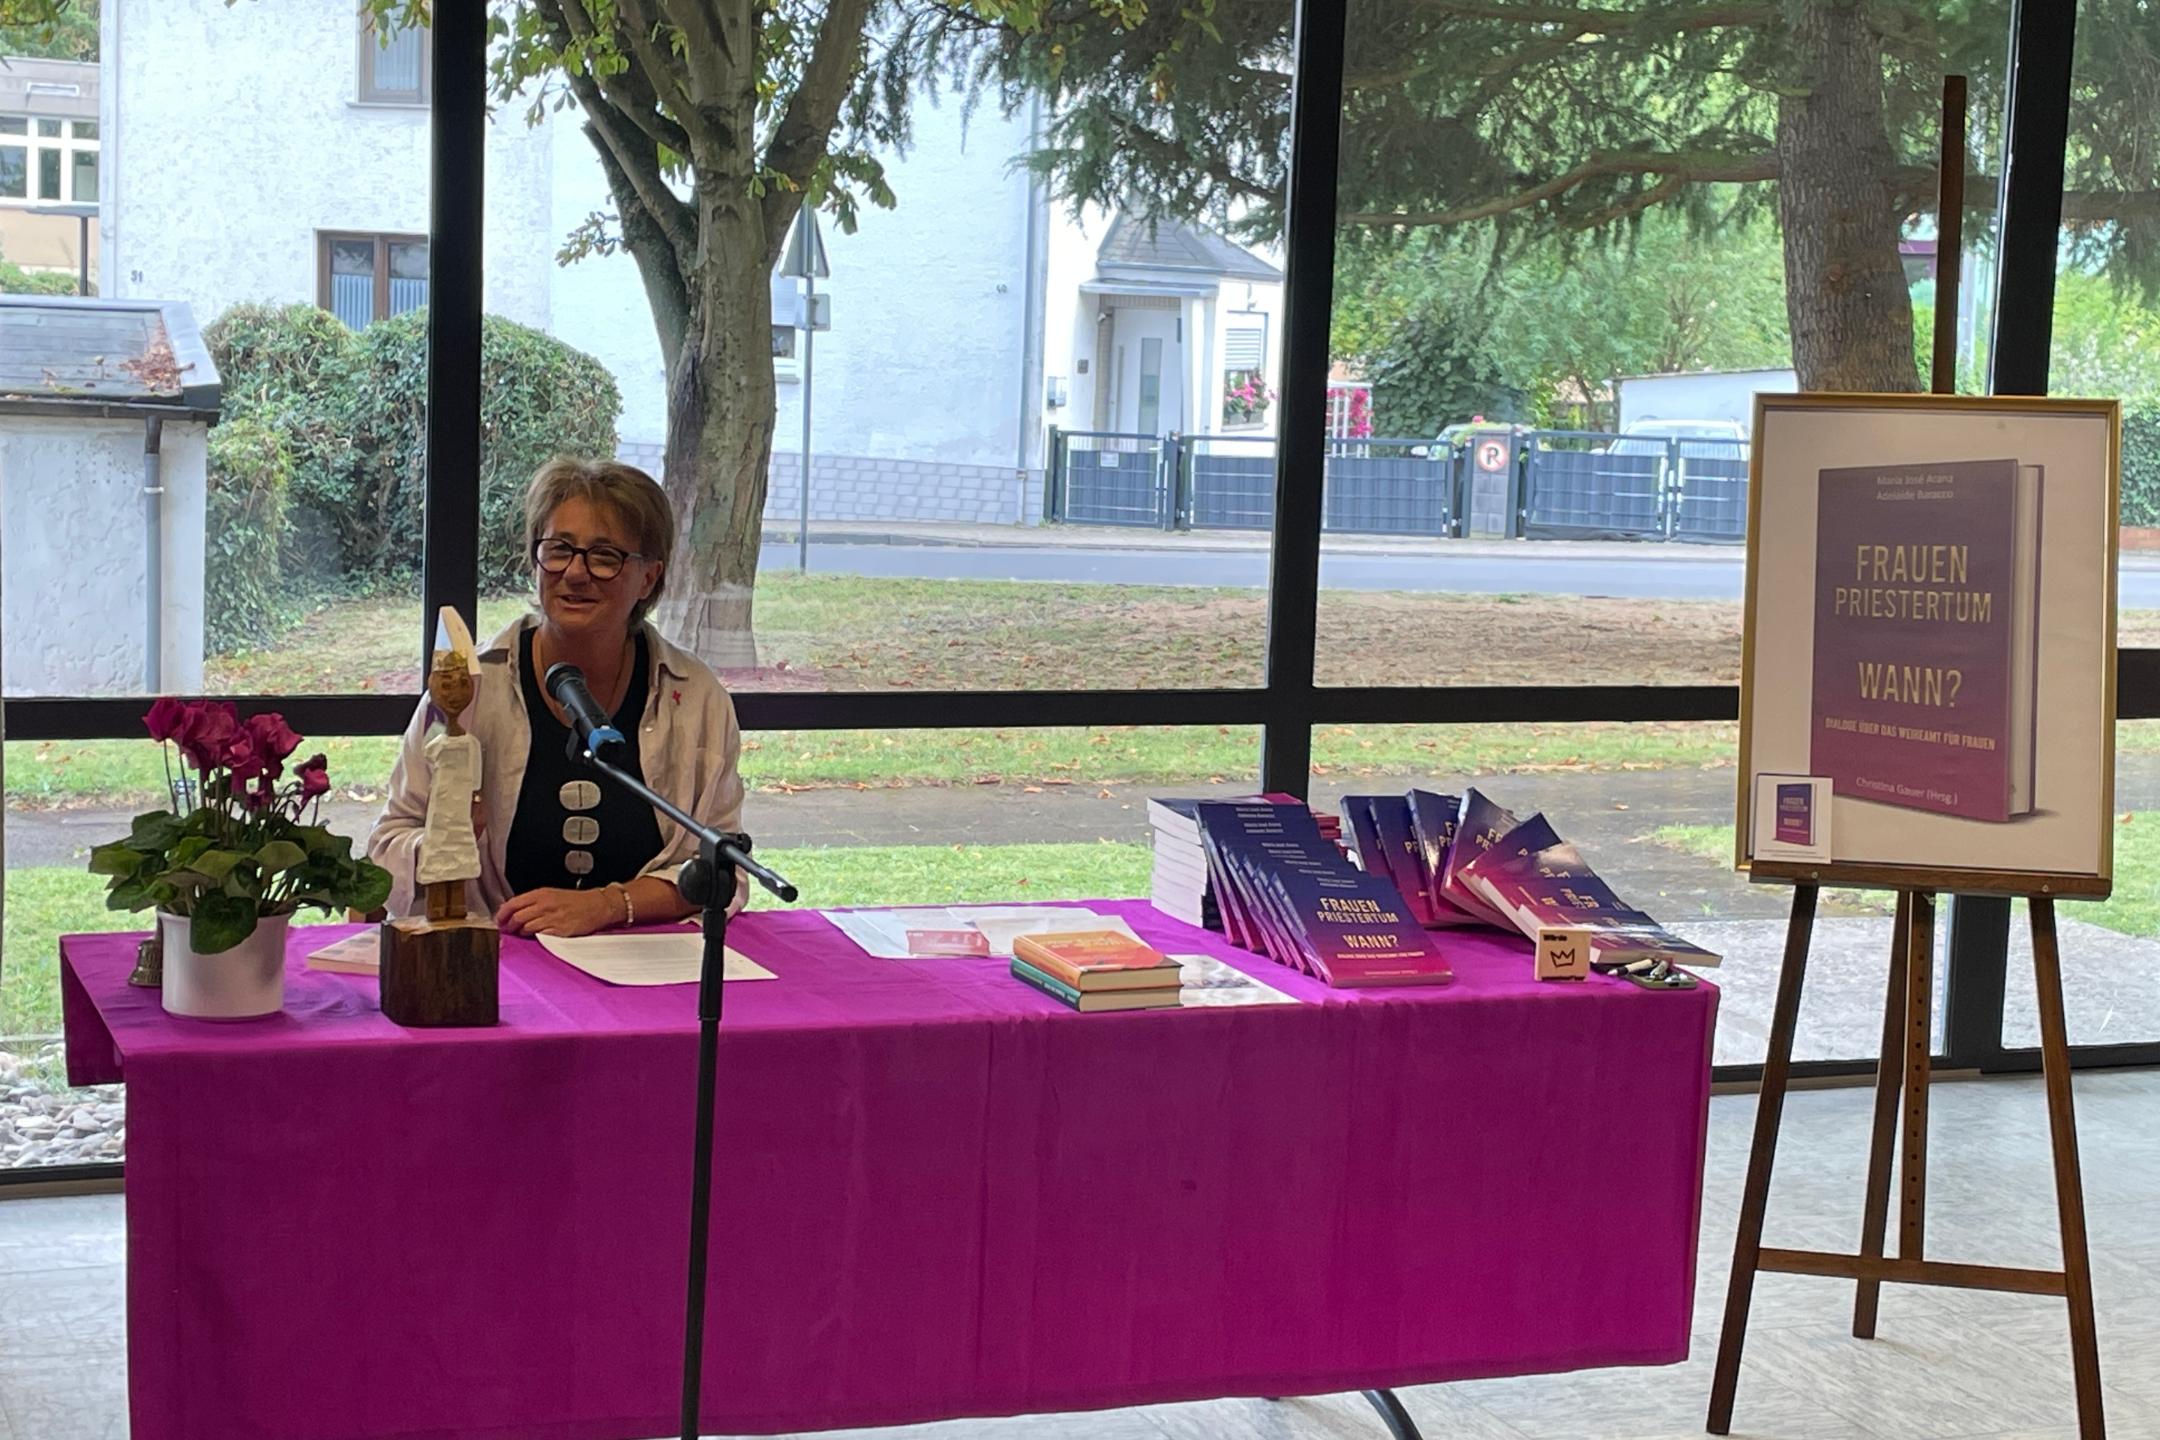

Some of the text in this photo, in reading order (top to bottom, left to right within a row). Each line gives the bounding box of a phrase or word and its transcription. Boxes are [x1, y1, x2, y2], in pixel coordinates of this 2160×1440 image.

[1856, 544, 1968, 584] FRAUEN
[1835, 587, 1992, 623] PRIESTERTUM
[1858, 661, 1962, 708] WANN?
[1825, 717, 1996, 751] DIALOGE ÜBER DAS WEIHEAMT FÜR FRAUEN
[1855, 776, 1895, 793] Christina
[1316, 911, 1400, 924] PRIESTERTUM
[1319, 897, 1381, 913] FRAUEN
[1342, 934, 1400, 948] WANN?
